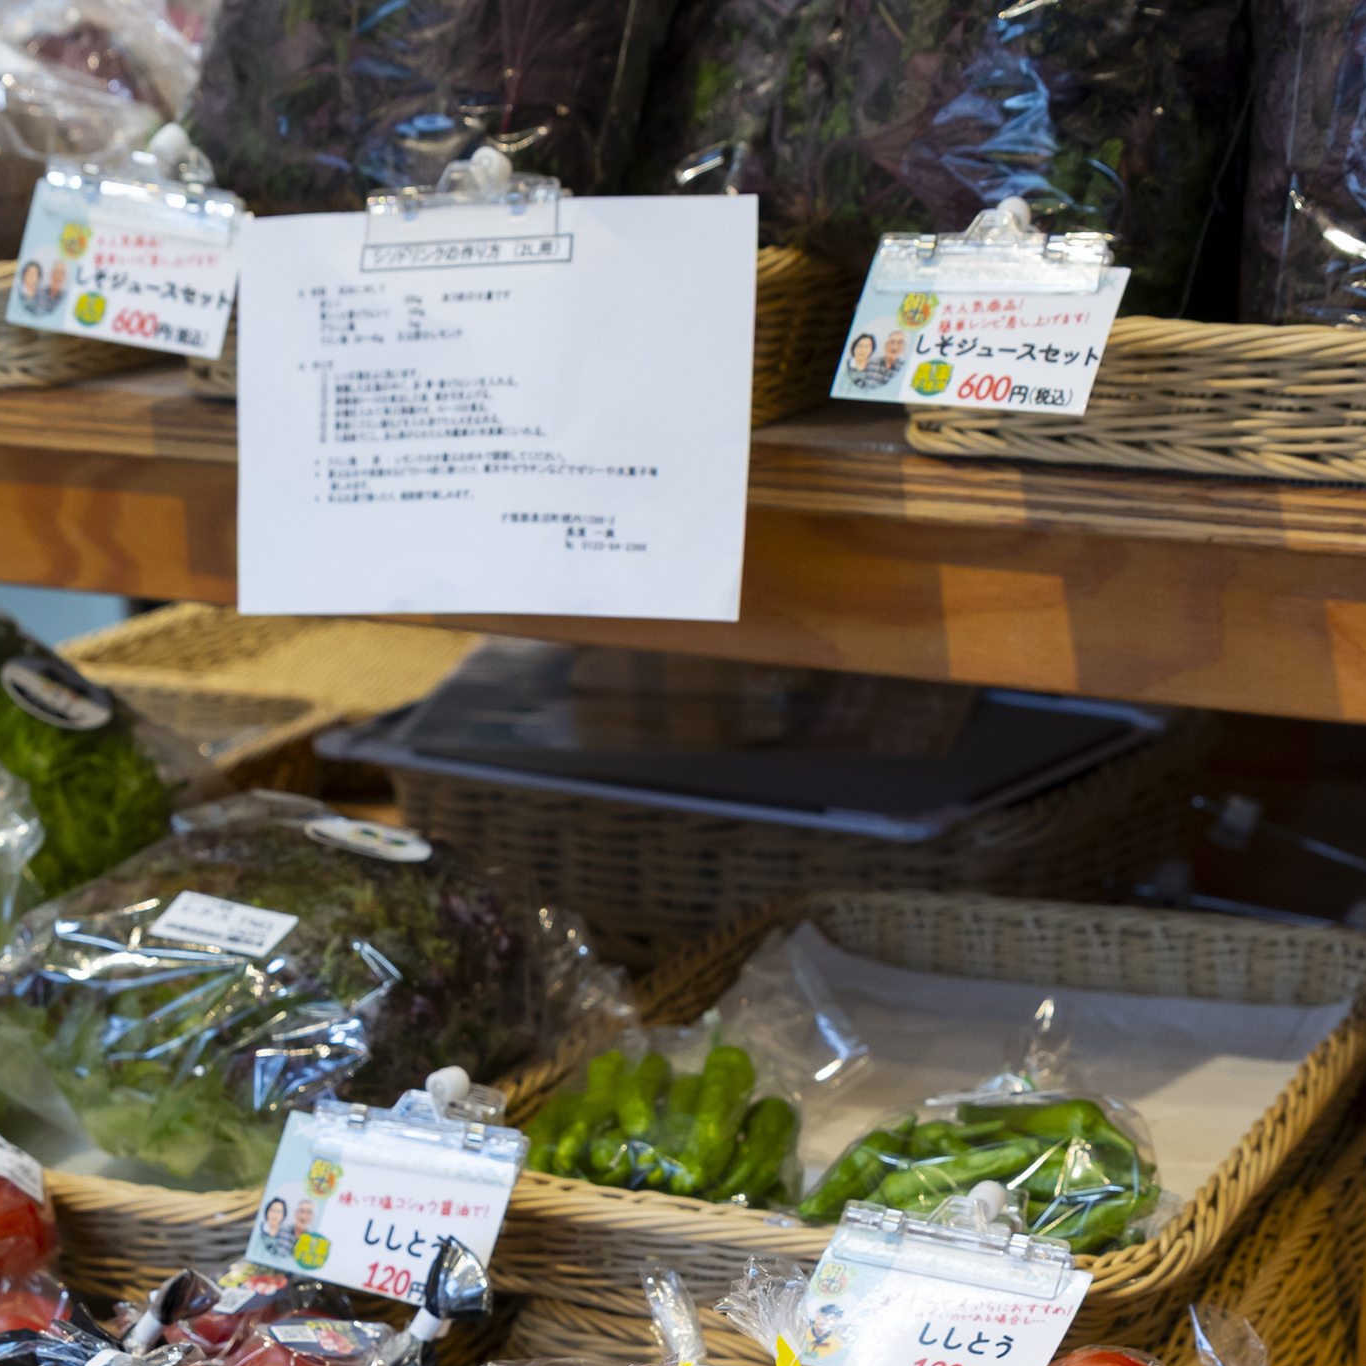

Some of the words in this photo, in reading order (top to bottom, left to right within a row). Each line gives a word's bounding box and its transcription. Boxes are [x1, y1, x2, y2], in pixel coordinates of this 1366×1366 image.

[75, 267, 231, 310] しそジュースセット
[916, 333, 1099, 366] しそジュースセット
[957, 373, 1073, 406] 600円(税込)
[918, 1322, 1015, 1359] ししとう
